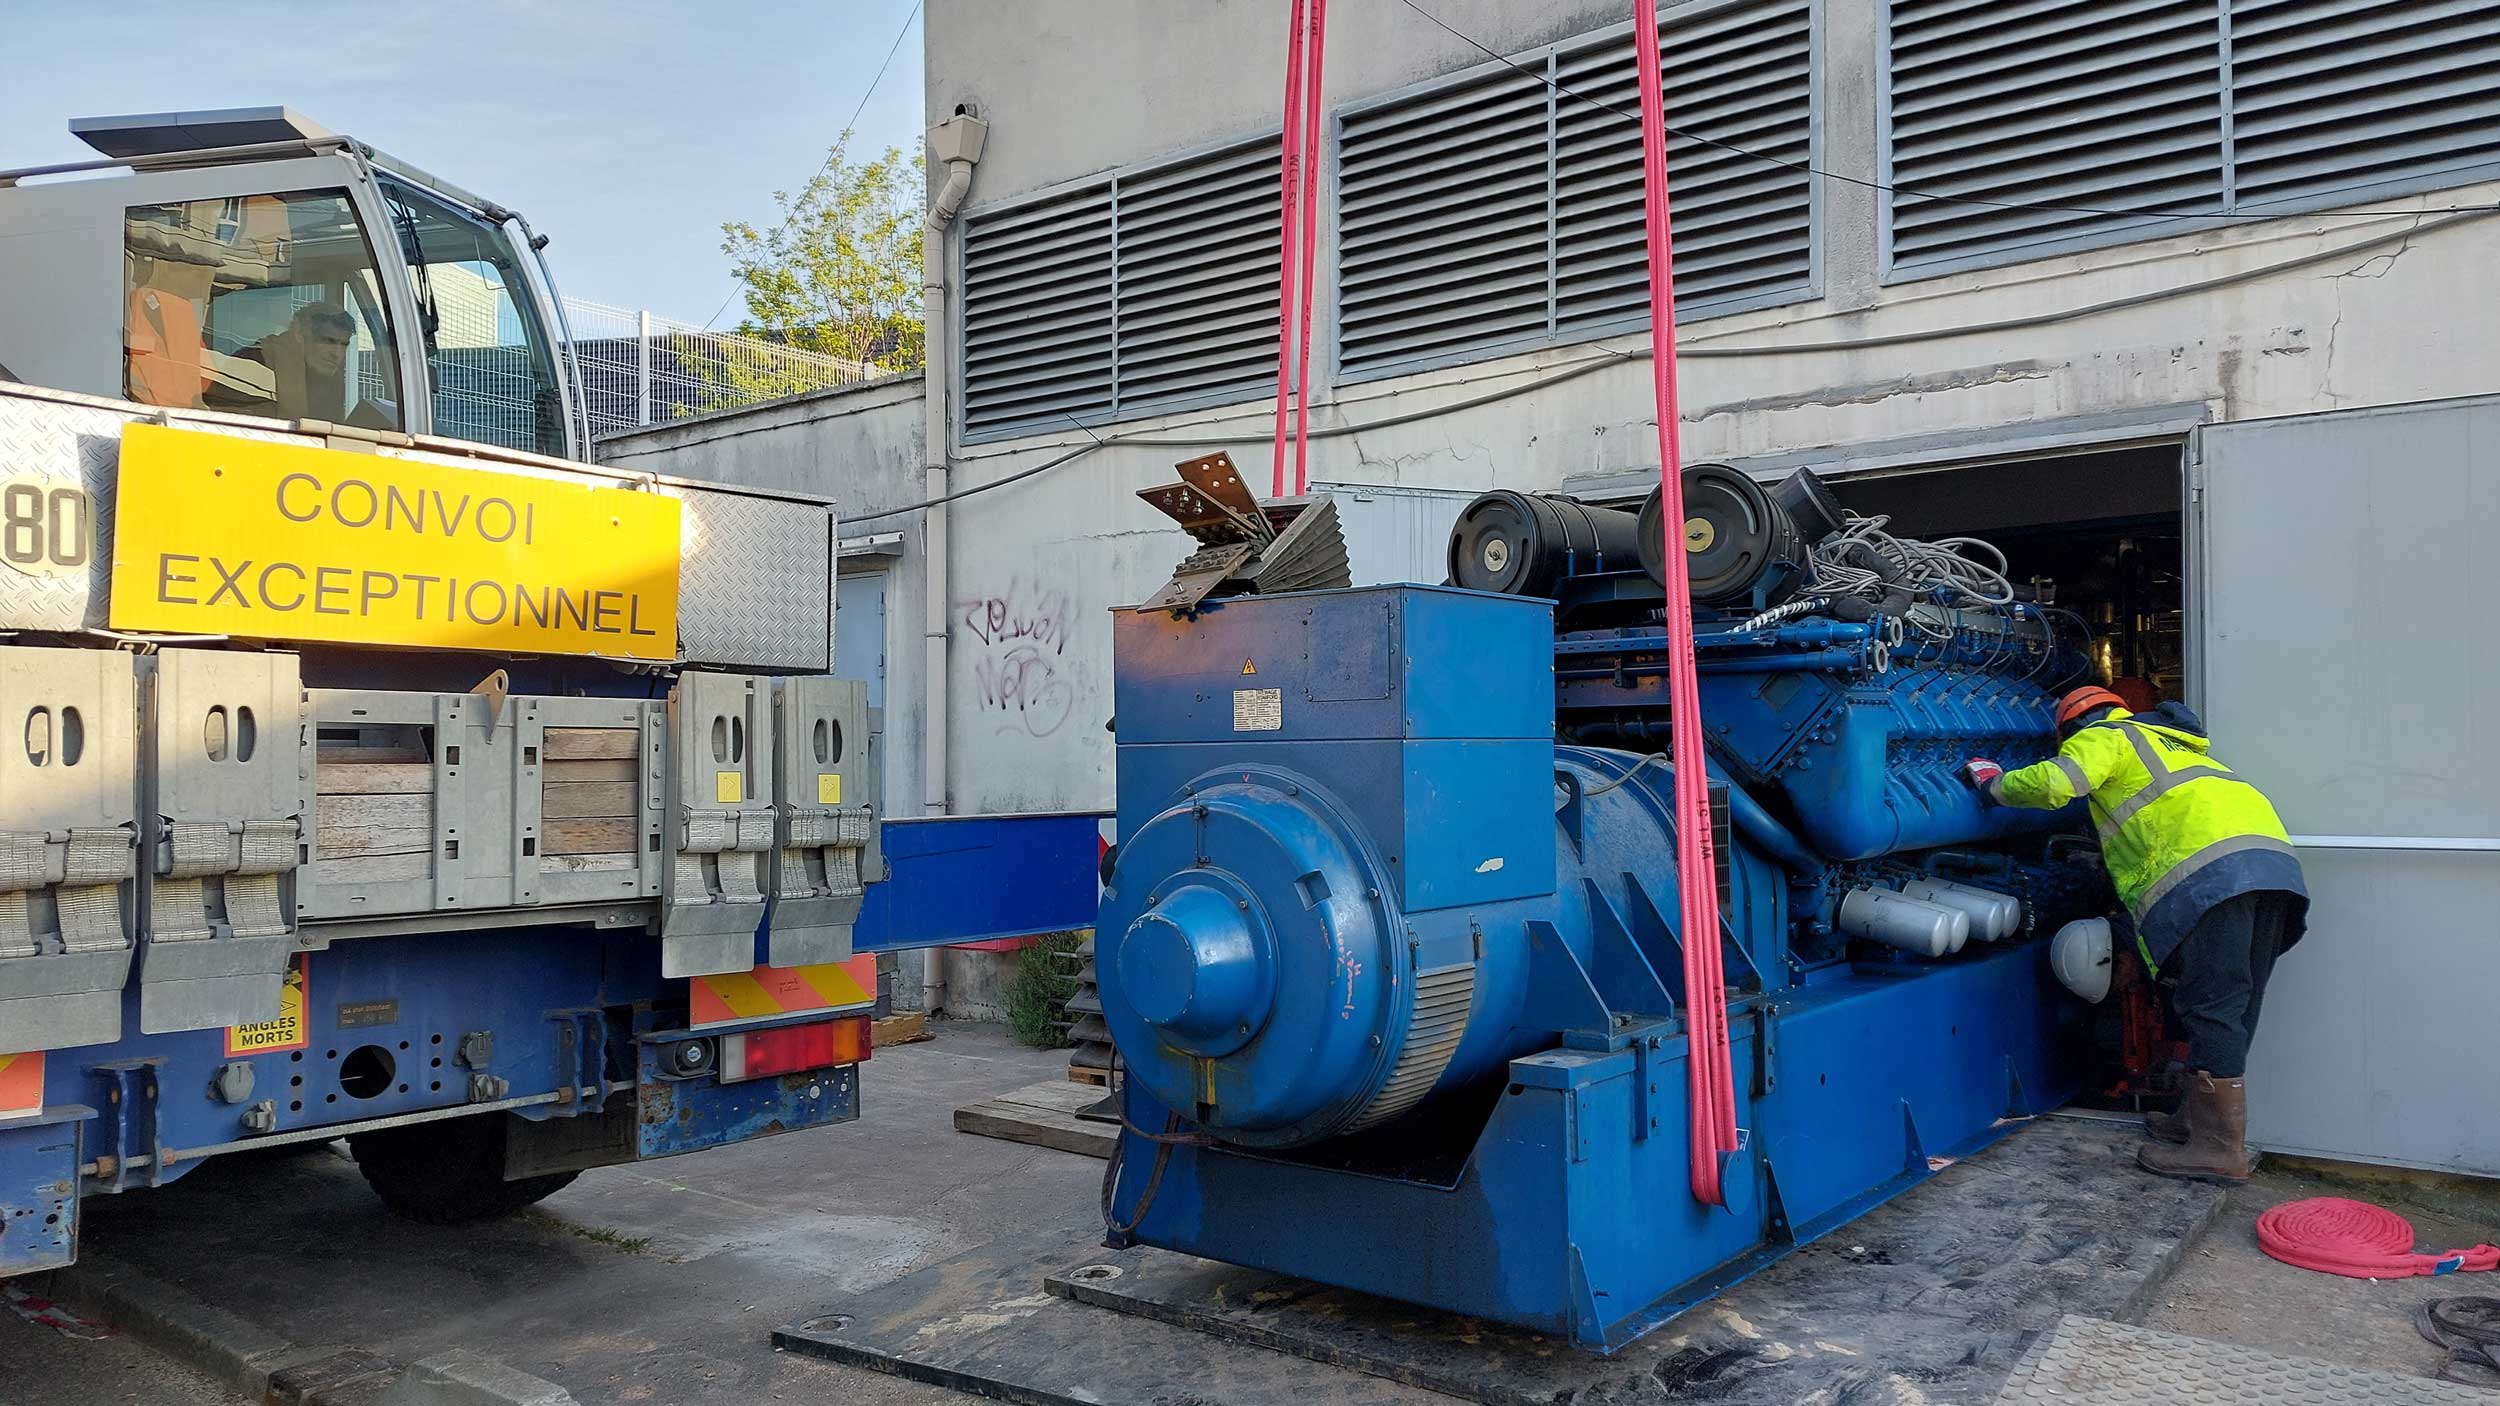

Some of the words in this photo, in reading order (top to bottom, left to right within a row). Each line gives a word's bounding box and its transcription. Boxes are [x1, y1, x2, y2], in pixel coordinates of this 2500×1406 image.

[5, 484, 87, 566] 80
[277, 472, 533, 545] CONVOI
[157, 552, 656, 636] EXCEPTIONNEL
[1698, 824, 1712, 860] WLL
[238, 1016, 296, 1034] ANGLES
[241, 1030, 294, 1047] MORTS
